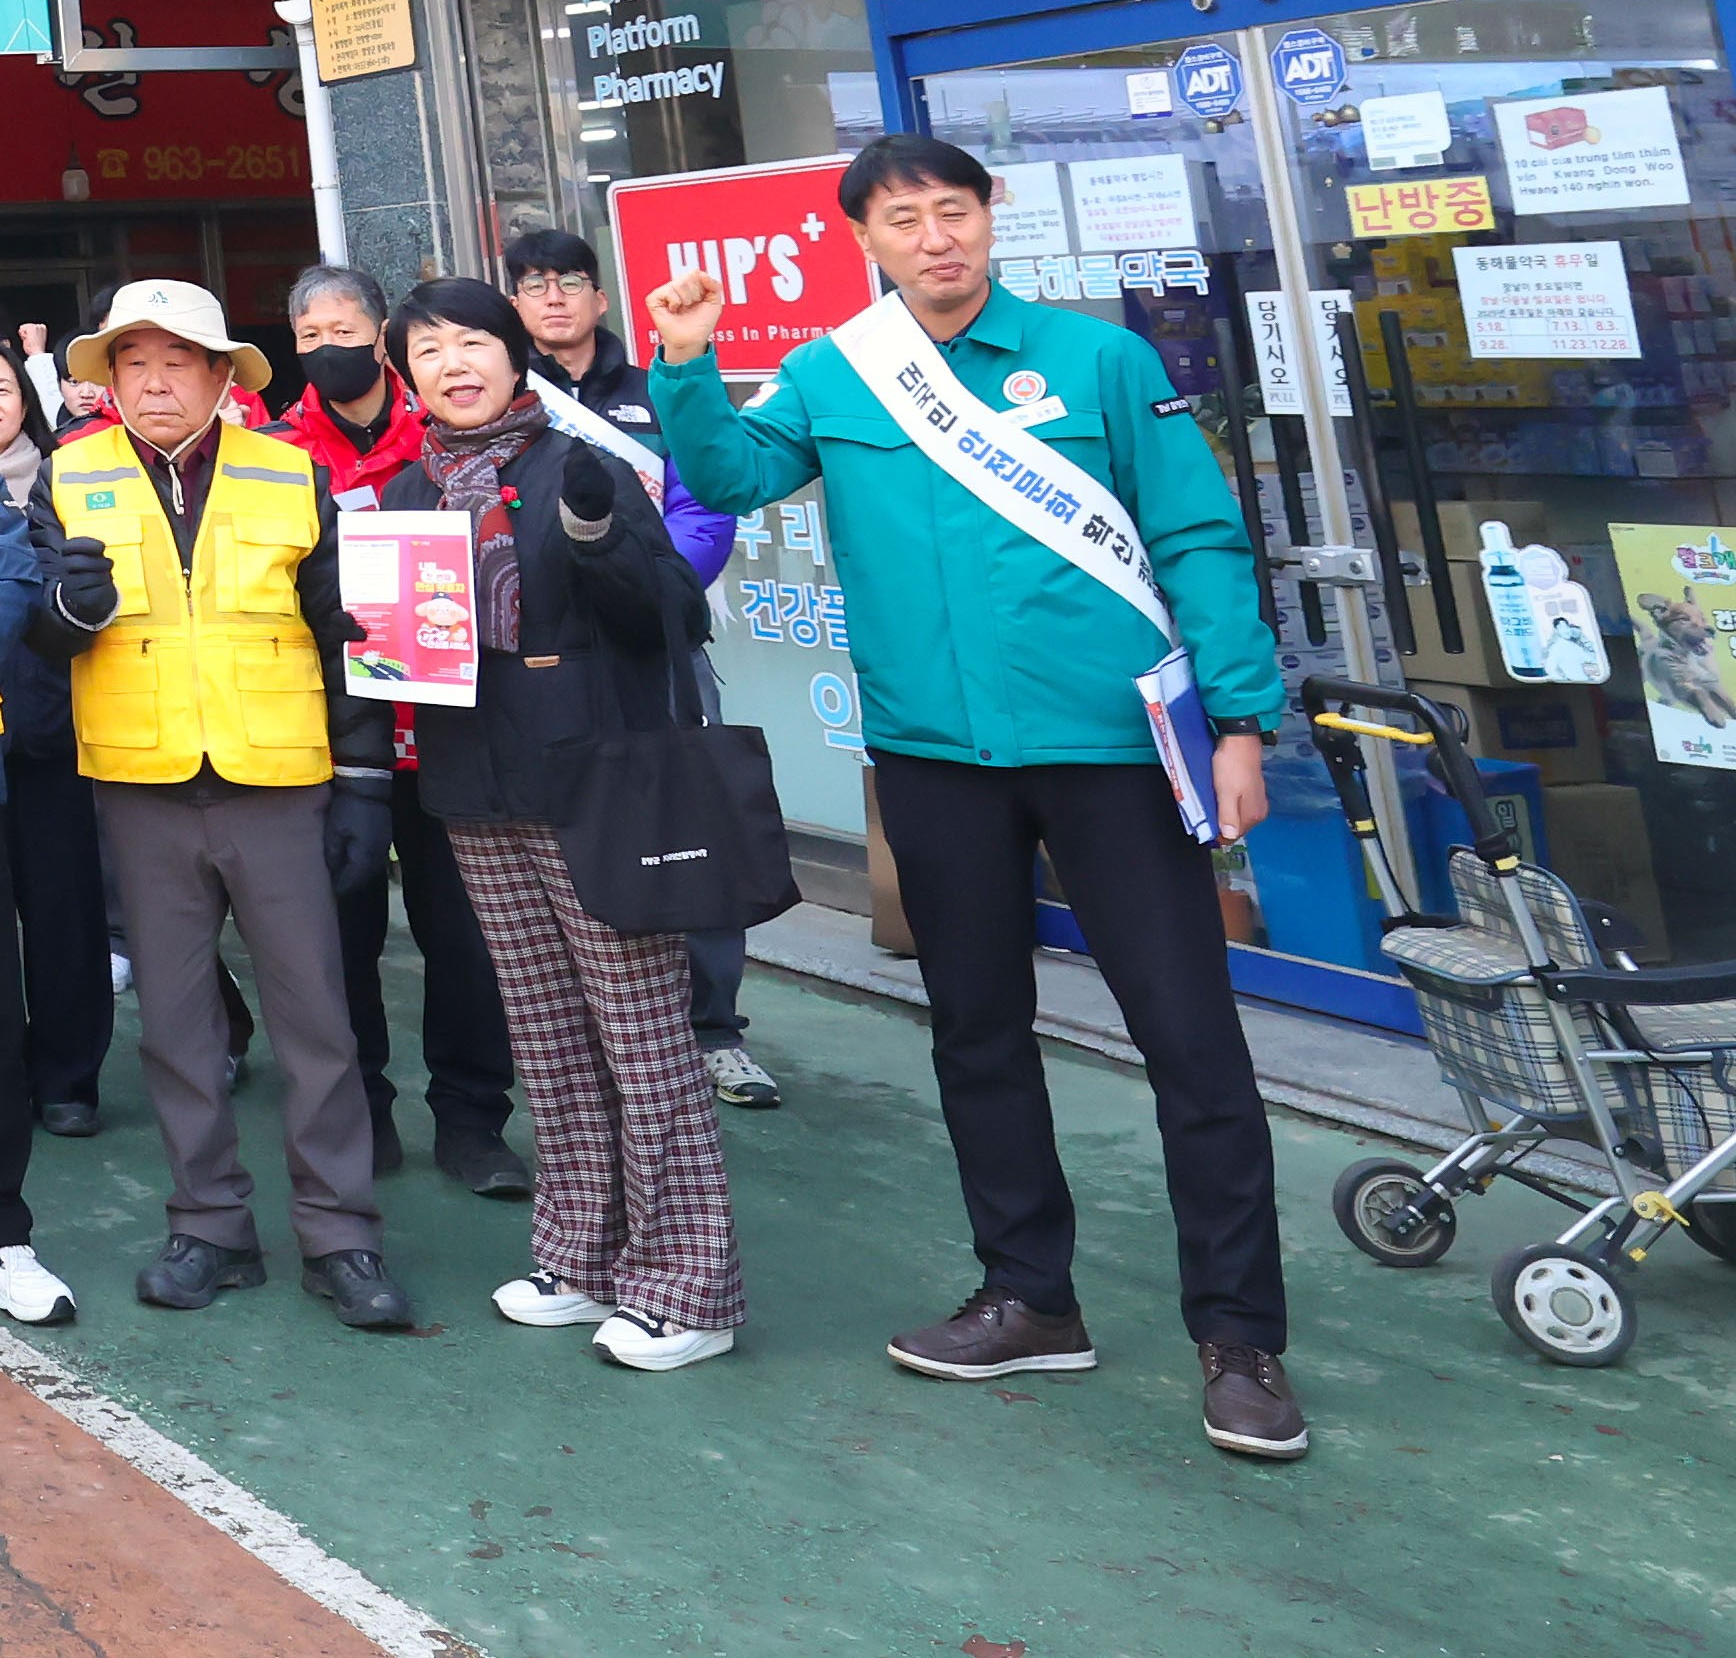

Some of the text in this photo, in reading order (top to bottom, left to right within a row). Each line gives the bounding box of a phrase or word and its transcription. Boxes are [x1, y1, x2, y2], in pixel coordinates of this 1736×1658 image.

[587, 12, 700, 59] Platform
[593, 61, 725, 104] Pharmacy
[1186, 64, 1231, 97] ADT
[1285, 50, 1333, 83] ADT
[143, 144, 301, 180] 963-2651
[1554, 168, 1595, 180] Kwang
[1603, 164, 1636, 175] Dong
[1645, 161, 1674, 172] Woo
[1354, 180, 1489, 232] 난방중
[1519, 185, 1559, 196] Hwang
[1563, 182, 1583, 192] 140
[998, 249, 1211, 302] 동해물약국
[1476, 252, 1599, 271] 동해물약국 휴무일
[767, 324, 835, 341] Pharma
[1258, 301, 1290, 384] 당기시오
[957, 427, 1082, 526] 안전문화
[1081, 512, 1135, 567] 확산
